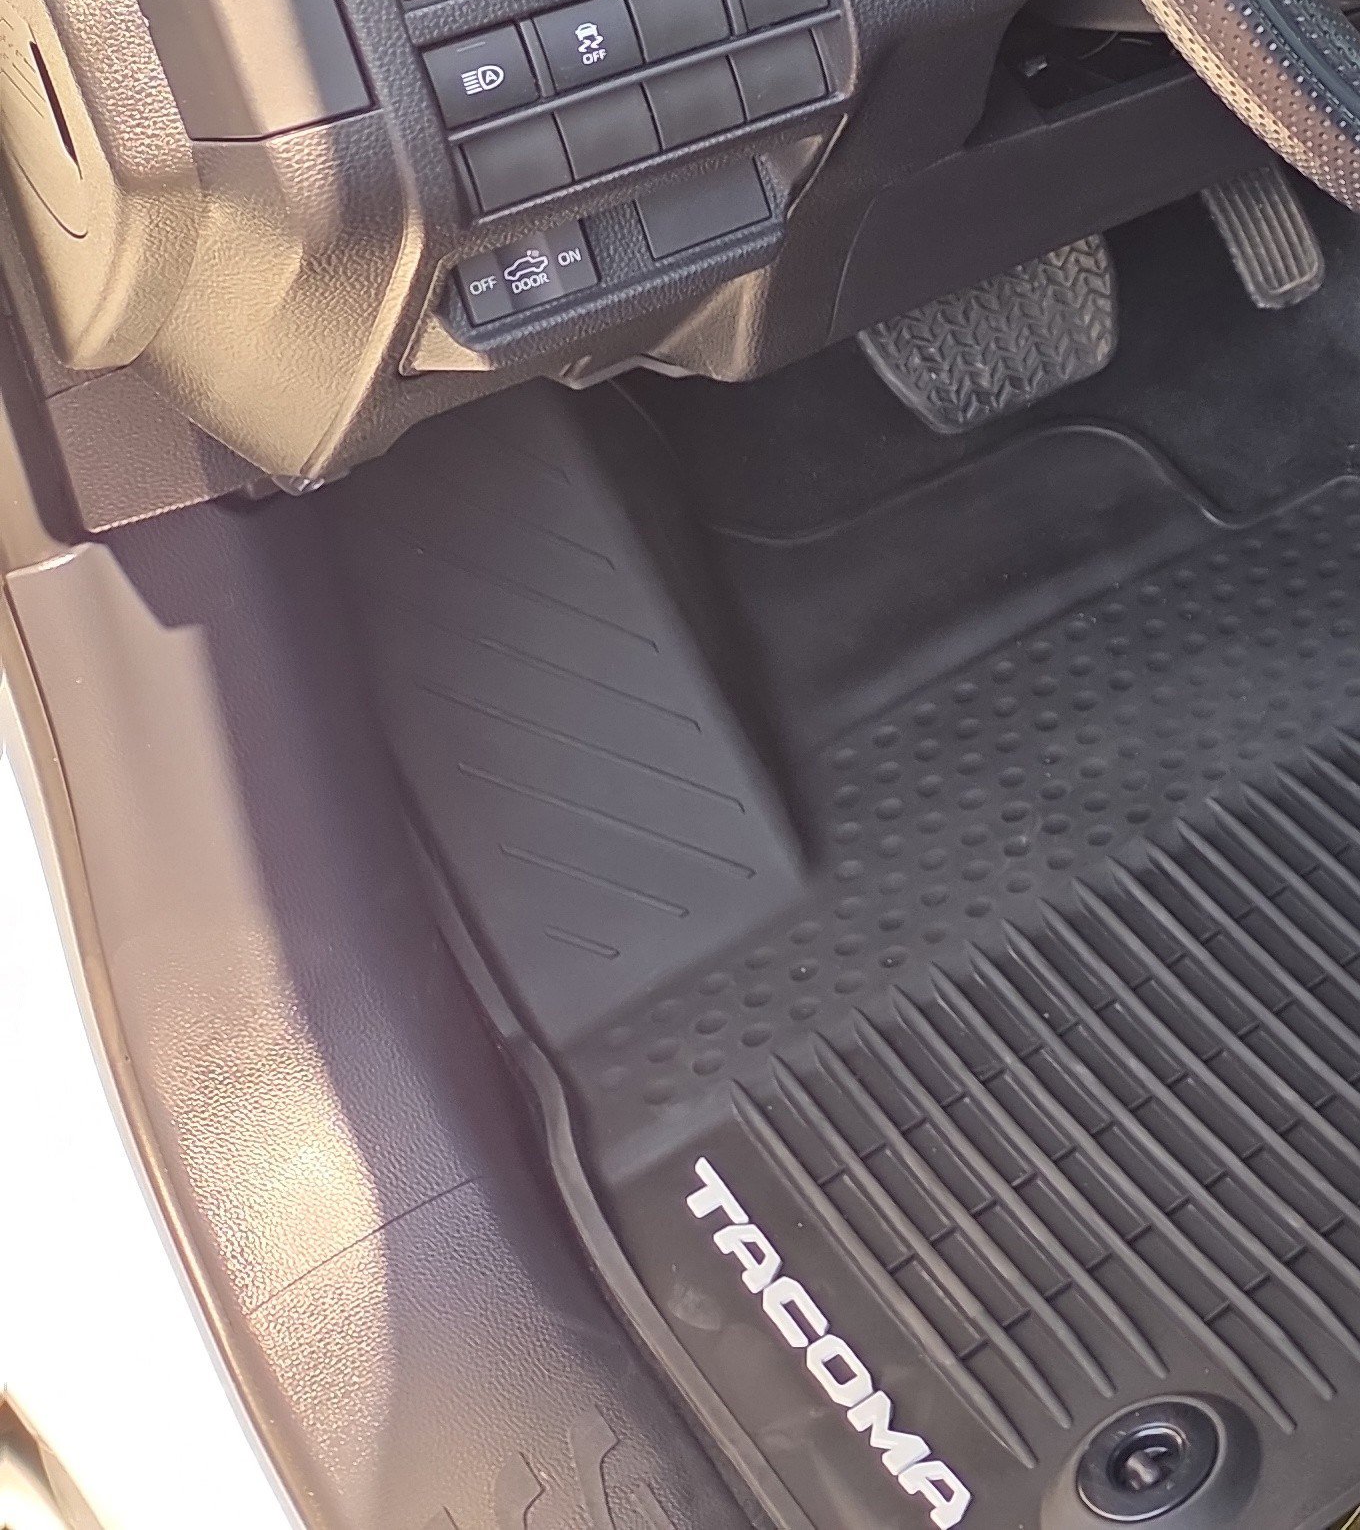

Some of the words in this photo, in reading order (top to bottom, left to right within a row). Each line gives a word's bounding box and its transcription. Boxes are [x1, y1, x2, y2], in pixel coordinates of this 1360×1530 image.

[582, 46, 607, 66] OFF
[469, 276, 498, 296] OFF
[557, 247, 582, 267] ON
[511, 271, 550, 294] DOOR
[686, 1155, 973, 1530] TACOMA
